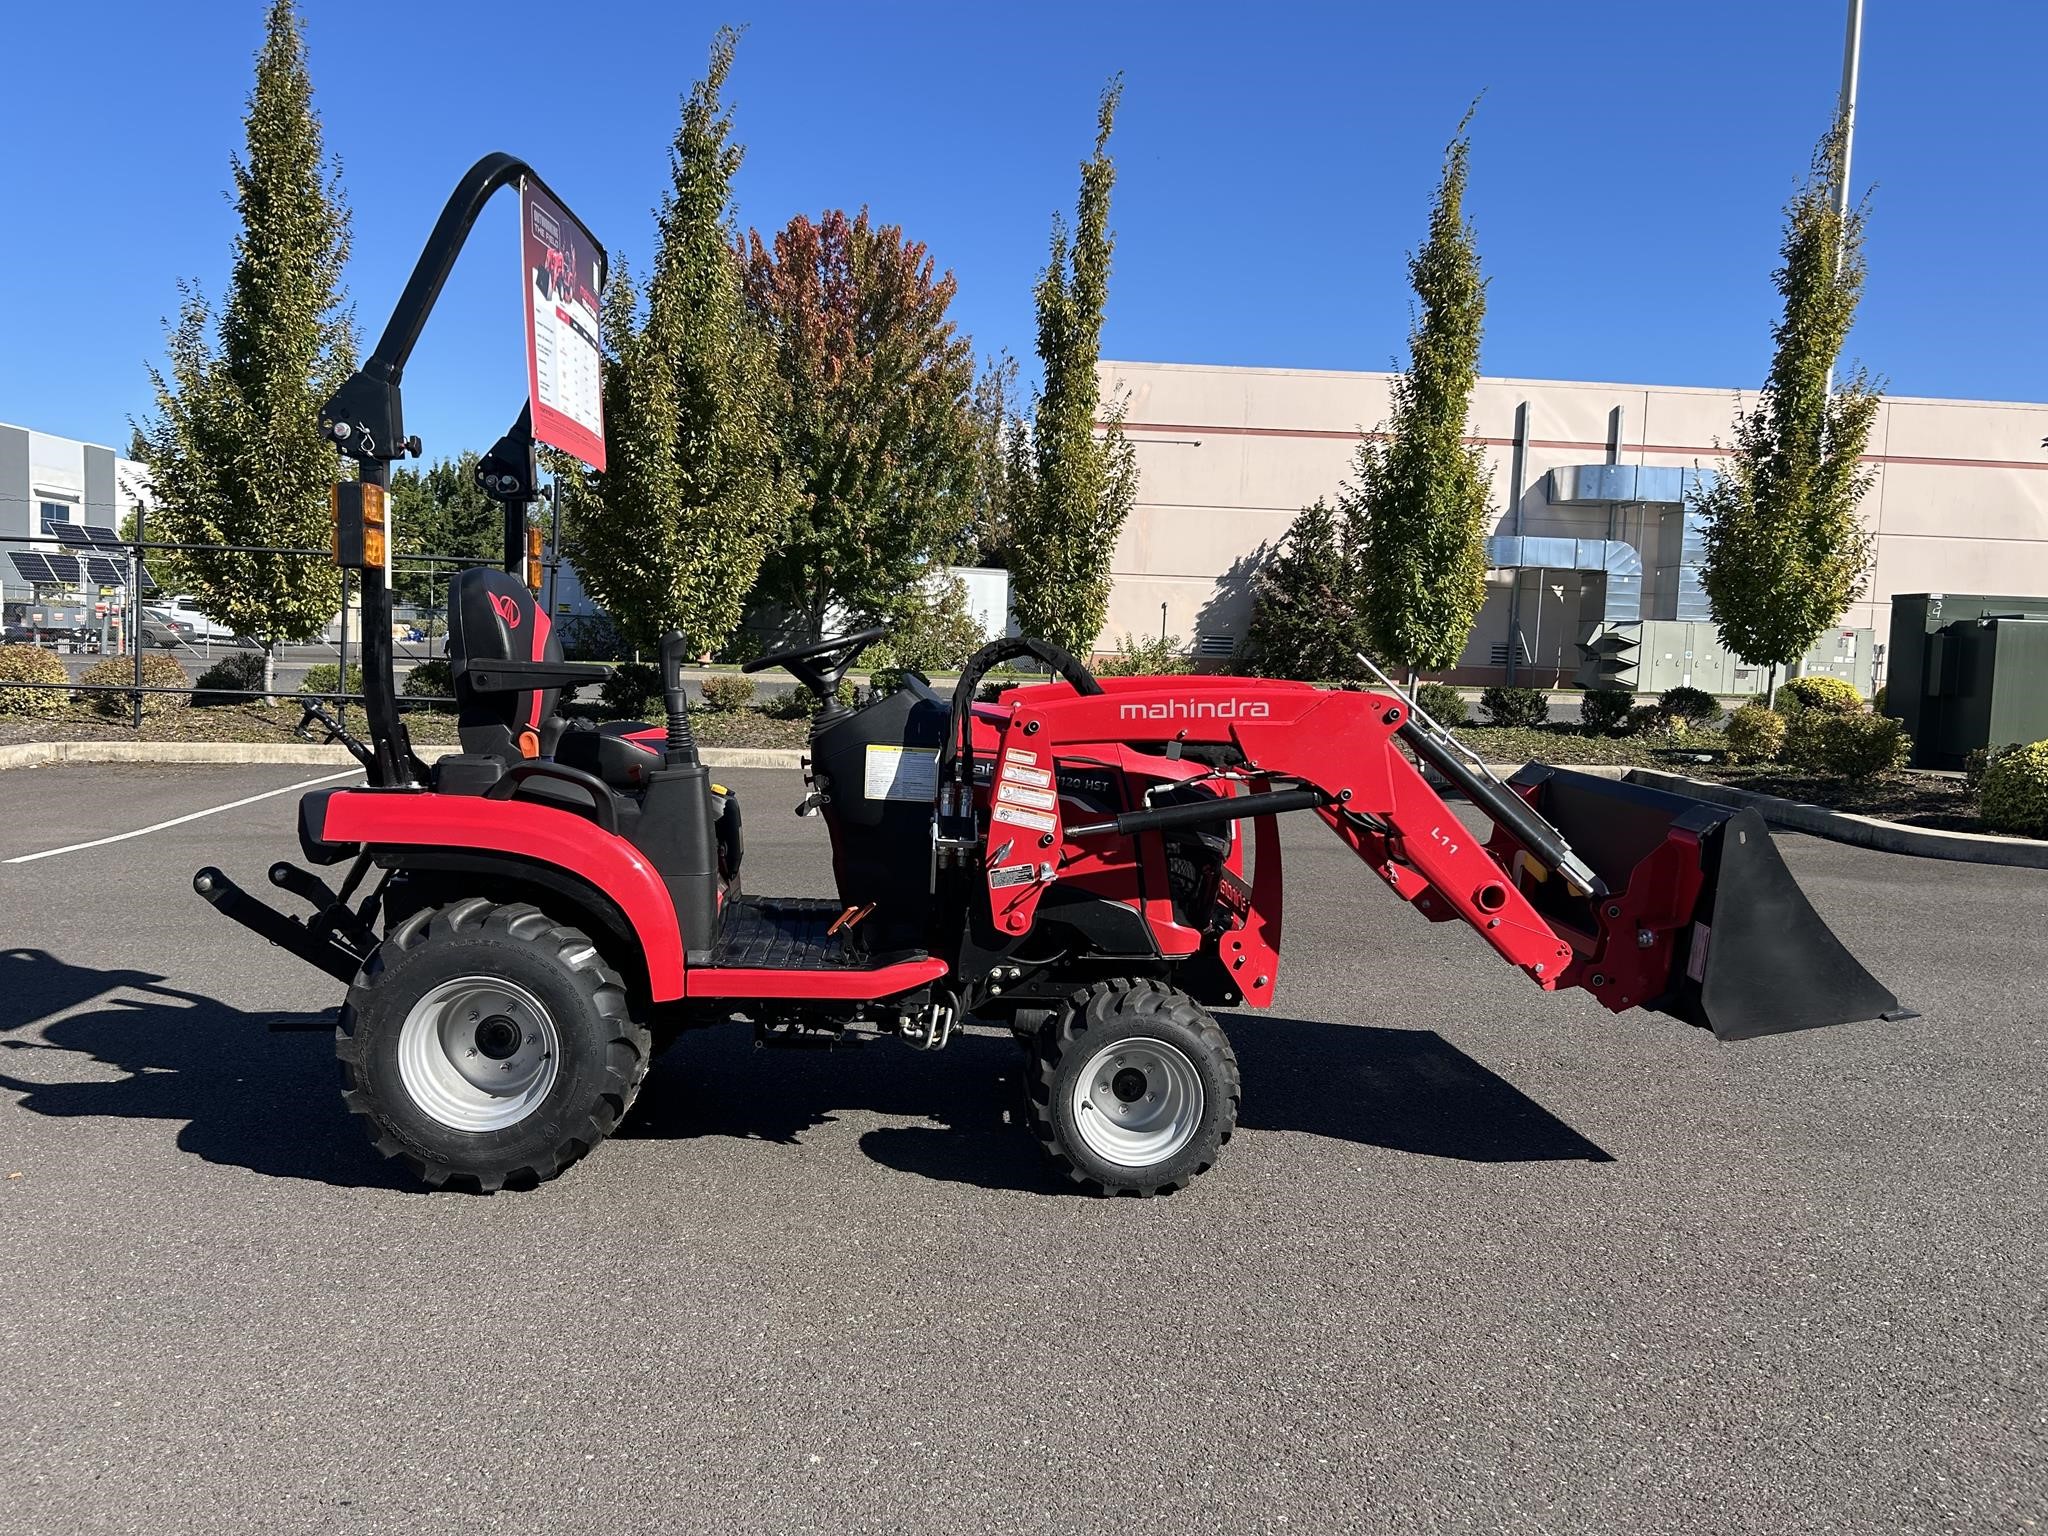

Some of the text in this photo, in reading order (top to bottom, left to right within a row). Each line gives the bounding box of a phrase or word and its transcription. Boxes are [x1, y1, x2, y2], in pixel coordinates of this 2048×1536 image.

[1120, 697, 1270, 720] mahindra
[1056, 775, 1081, 789] 1120
[1085, 779, 1109, 792] HST
[1431, 826, 1459, 855] L11
